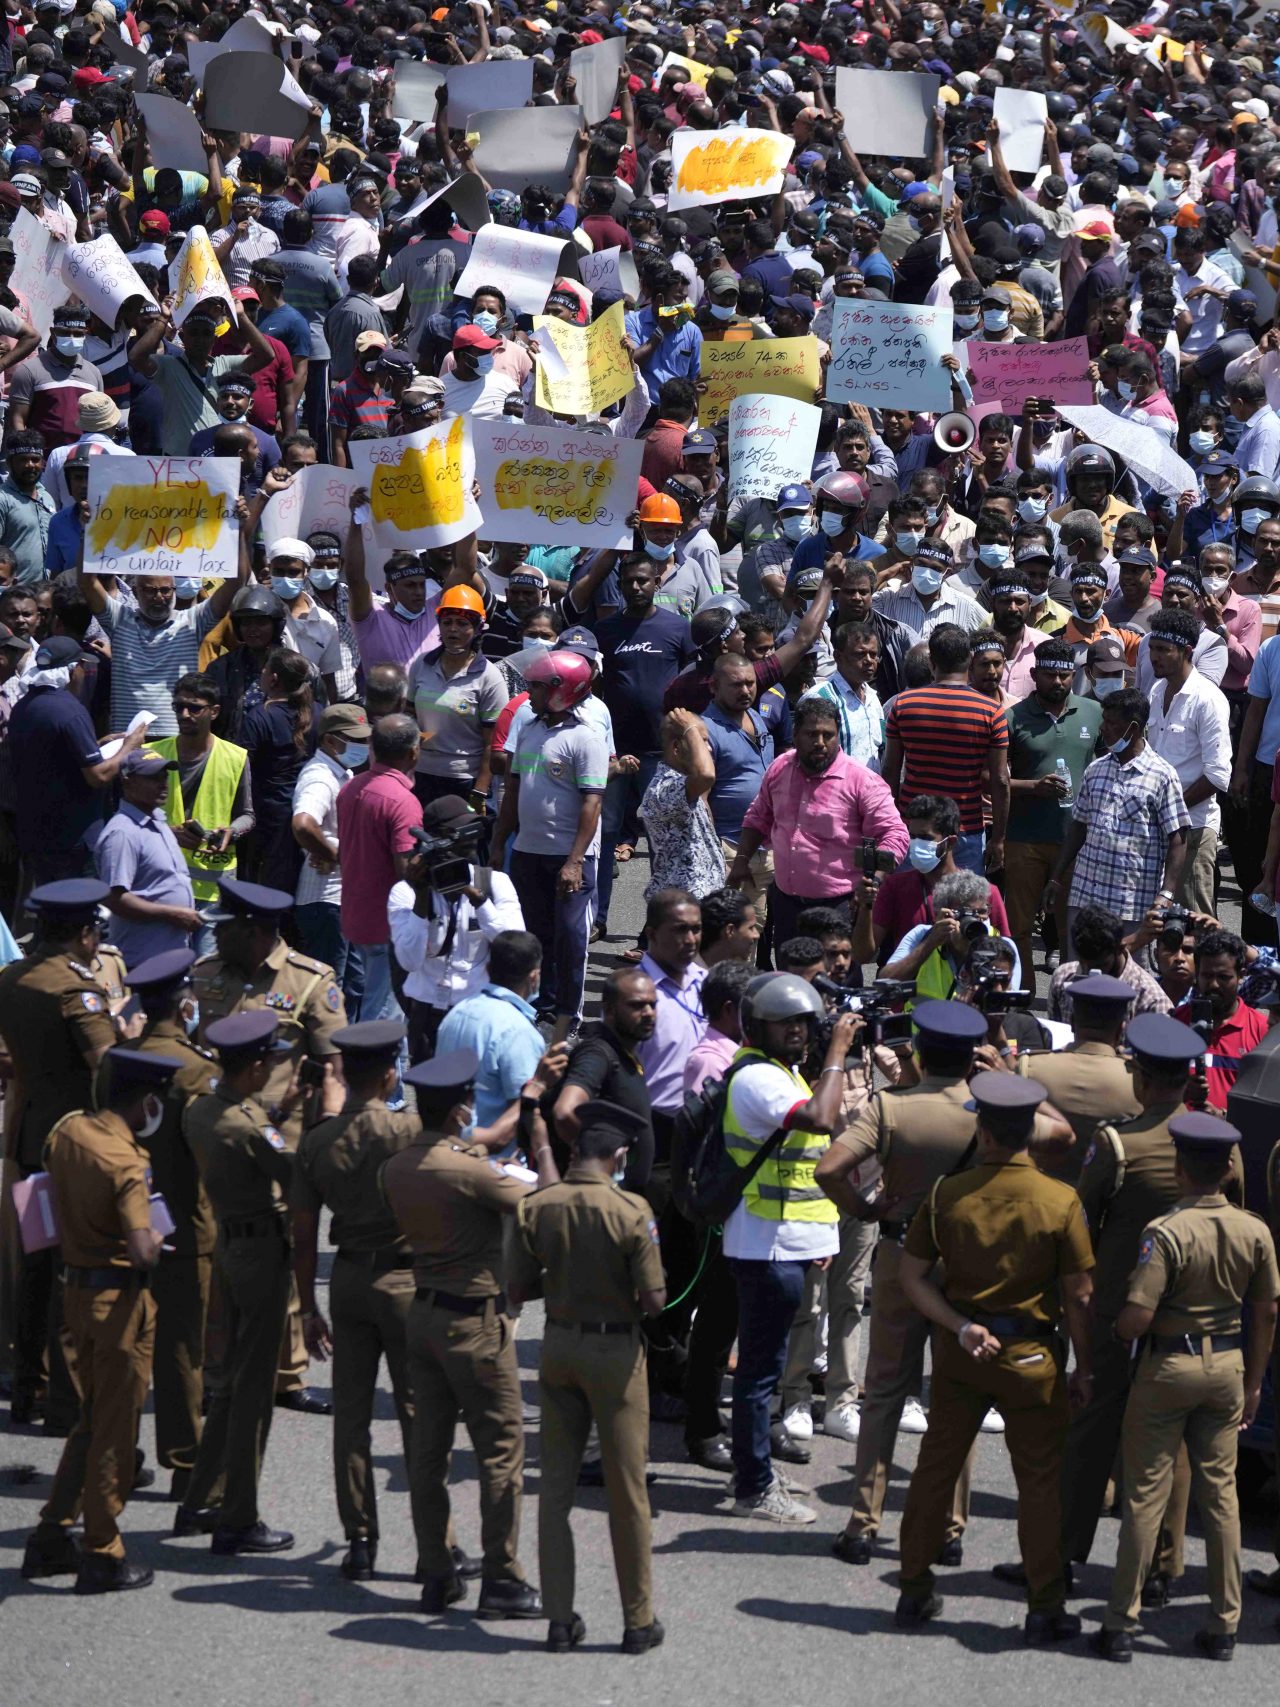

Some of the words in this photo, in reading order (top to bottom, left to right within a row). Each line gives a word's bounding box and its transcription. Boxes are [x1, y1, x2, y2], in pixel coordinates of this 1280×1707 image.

[755, 350, 774, 366] 74
[147, 458, 202, 489] YES
[95, 496, 112, 521] to
[124, 498, 208, 520] reasonable
[146, 526, 183, 549] NO
[100, 555, 117, 570] to
[129, 551, 182, 570] unfair
[199, 553, 229, 572] tax
[614, 640, 662, 655] Lacoste
[1173, 635, 1190, 646] TAX
[779, 1167, 815, 1180] PRE
